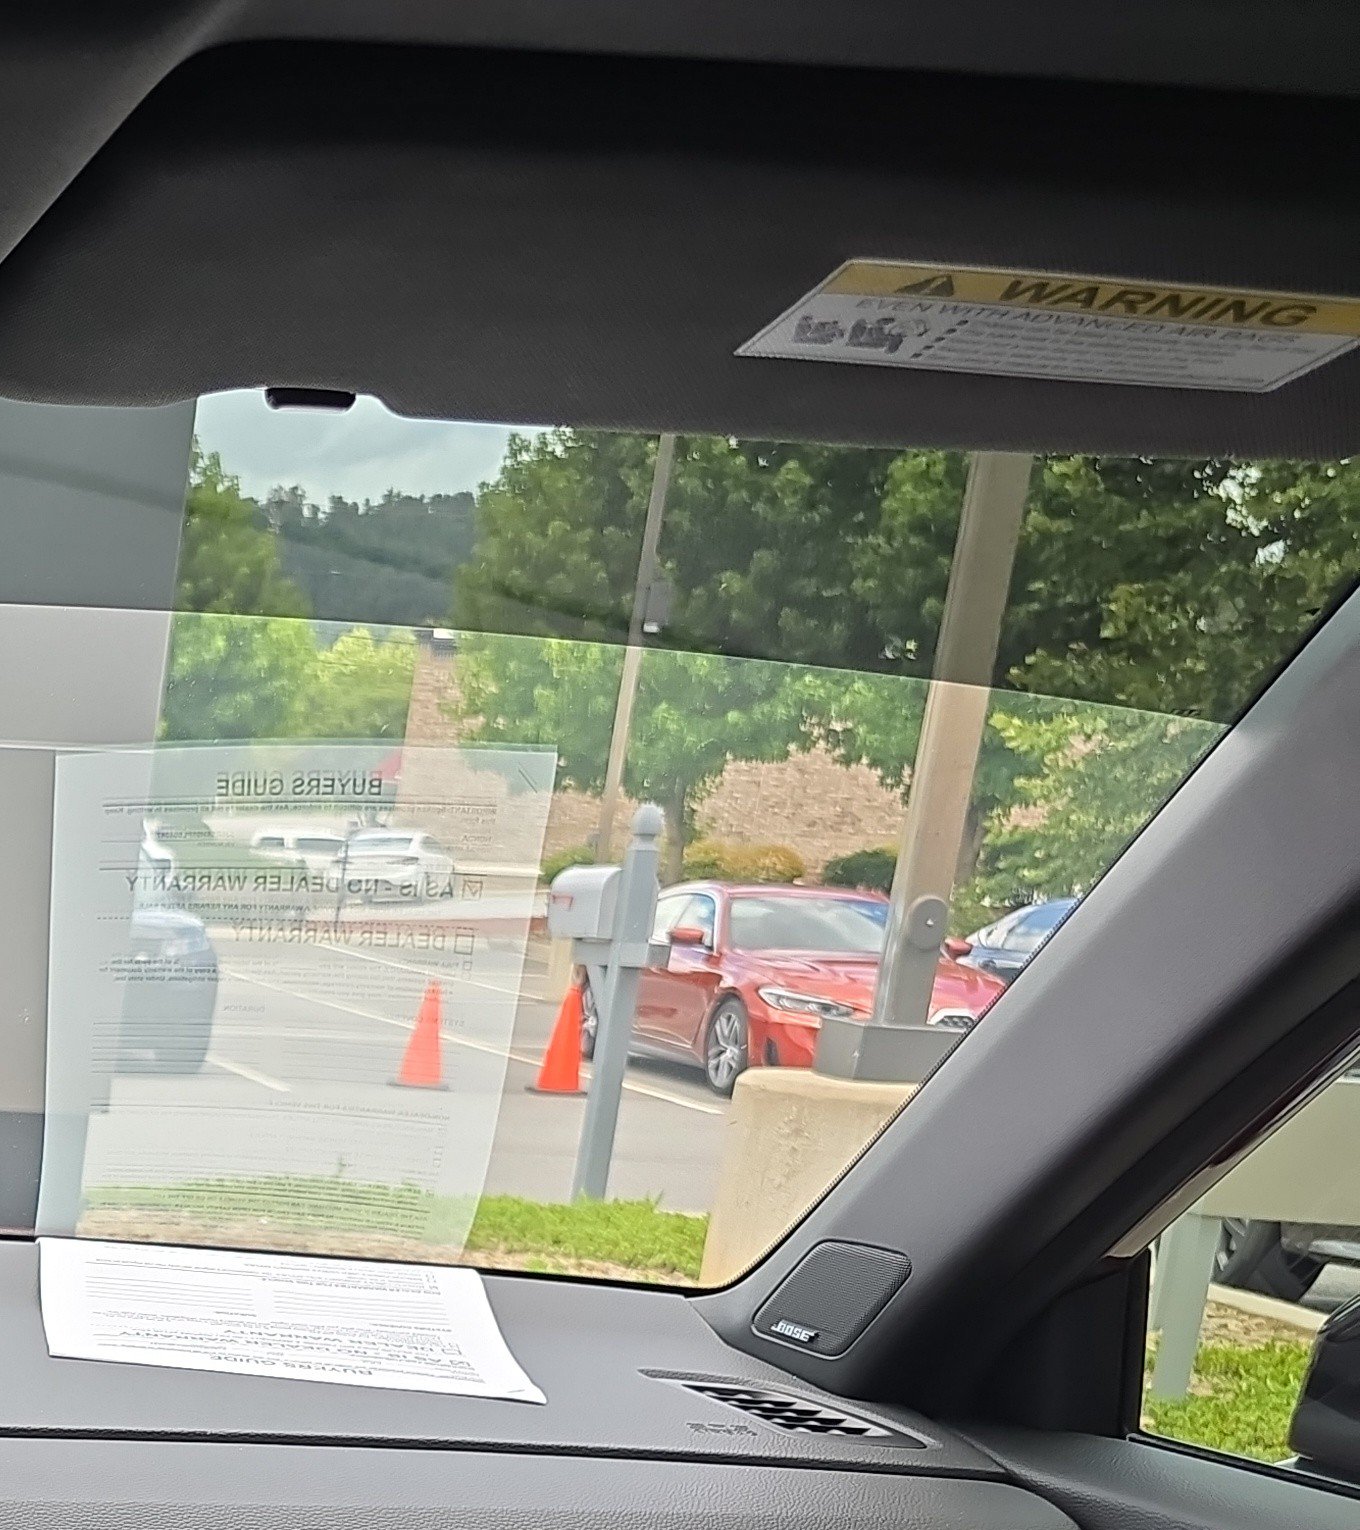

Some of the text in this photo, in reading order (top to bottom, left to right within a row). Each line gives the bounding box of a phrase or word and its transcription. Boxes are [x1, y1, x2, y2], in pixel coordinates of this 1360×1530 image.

[855, 299, 933, 313] EVEN
[937, 303, 1010, 318] WITH
[1013, 311, 1166, 334] ADVANCED
[999, 279, 1318, 327] WARNING
[770, 1319, 820, 1343] BOSE
[209, 1354, 278, 1367] GUIDE
